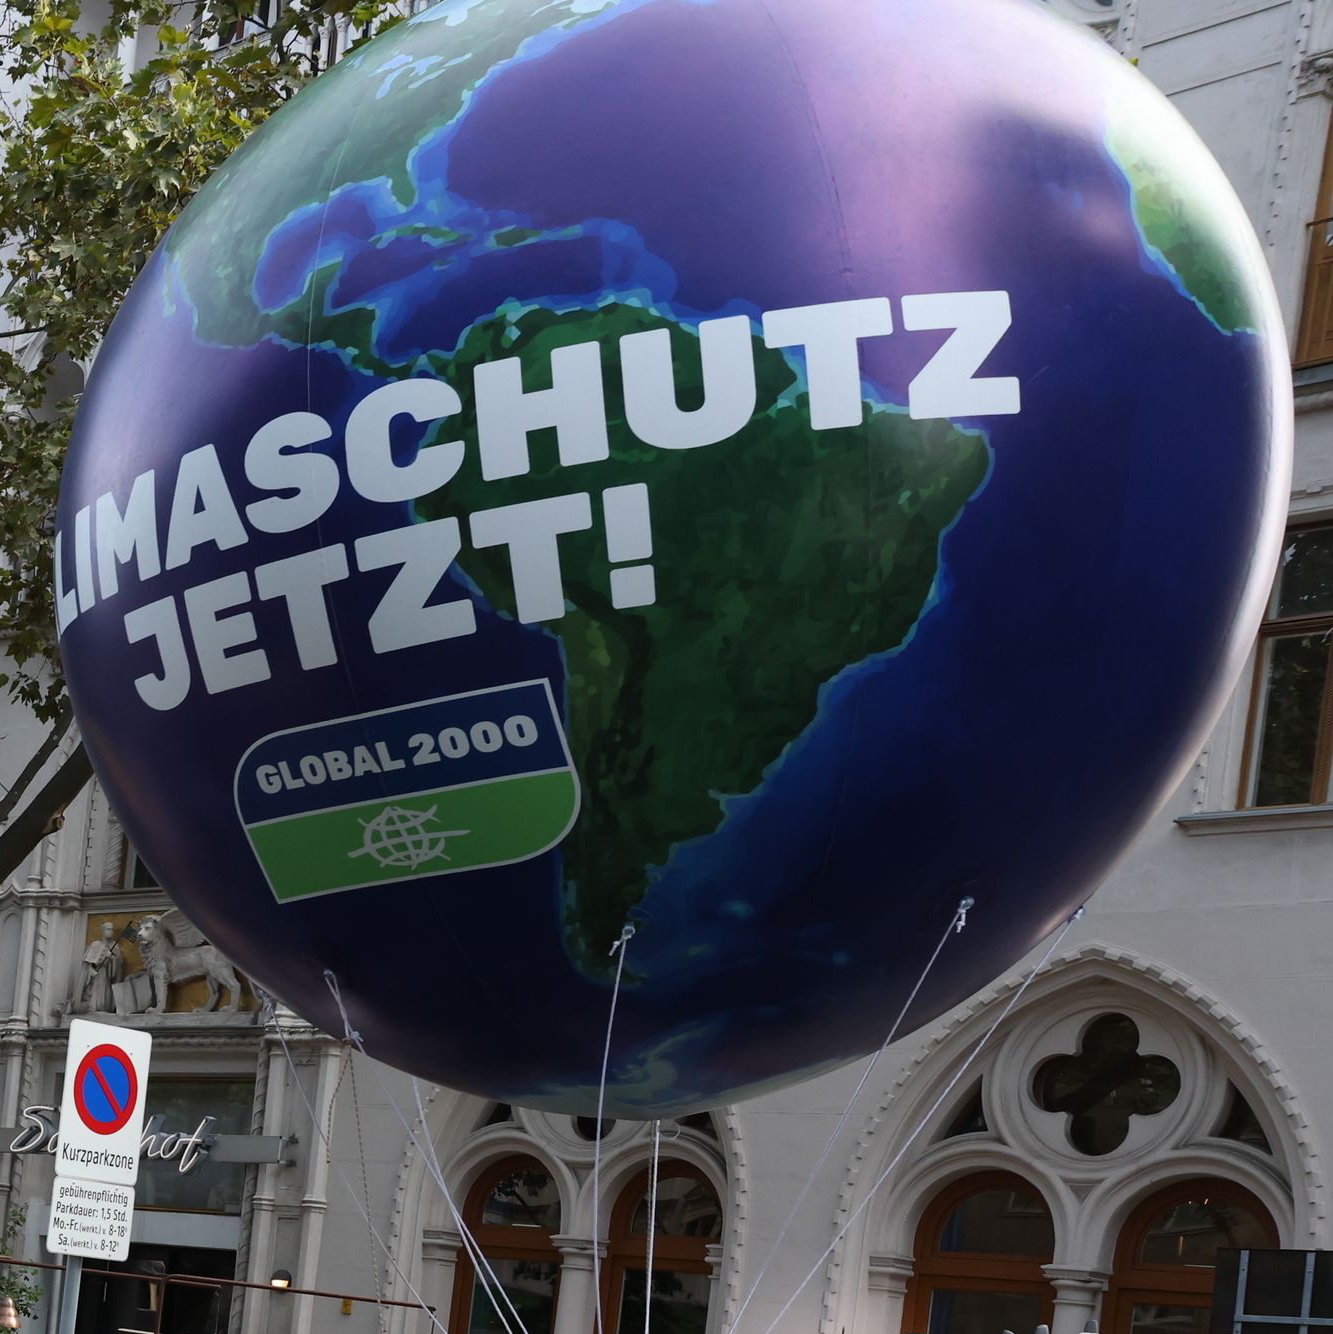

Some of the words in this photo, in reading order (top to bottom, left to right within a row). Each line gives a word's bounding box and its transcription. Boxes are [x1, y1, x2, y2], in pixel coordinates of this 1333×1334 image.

[53, 290, 1020, 642] LIMASCHUTZ
[123, 482, 655, 712] JETZT!
[255, 742, 405, 796] GLOBAL
[412, 714, 538, 762] 2000
[62, 1142, 134, 1170] Kurzparkzone
[59, 1184, 129, 1206] gebührenpflichtig
[55, 1201, 98, 1219] Parkdauer:
[101, 1208, 112, 1221] 1,5
[113, 1209, 128, 1223] Std.
[58, 1234, 70, 1247] Sa.
